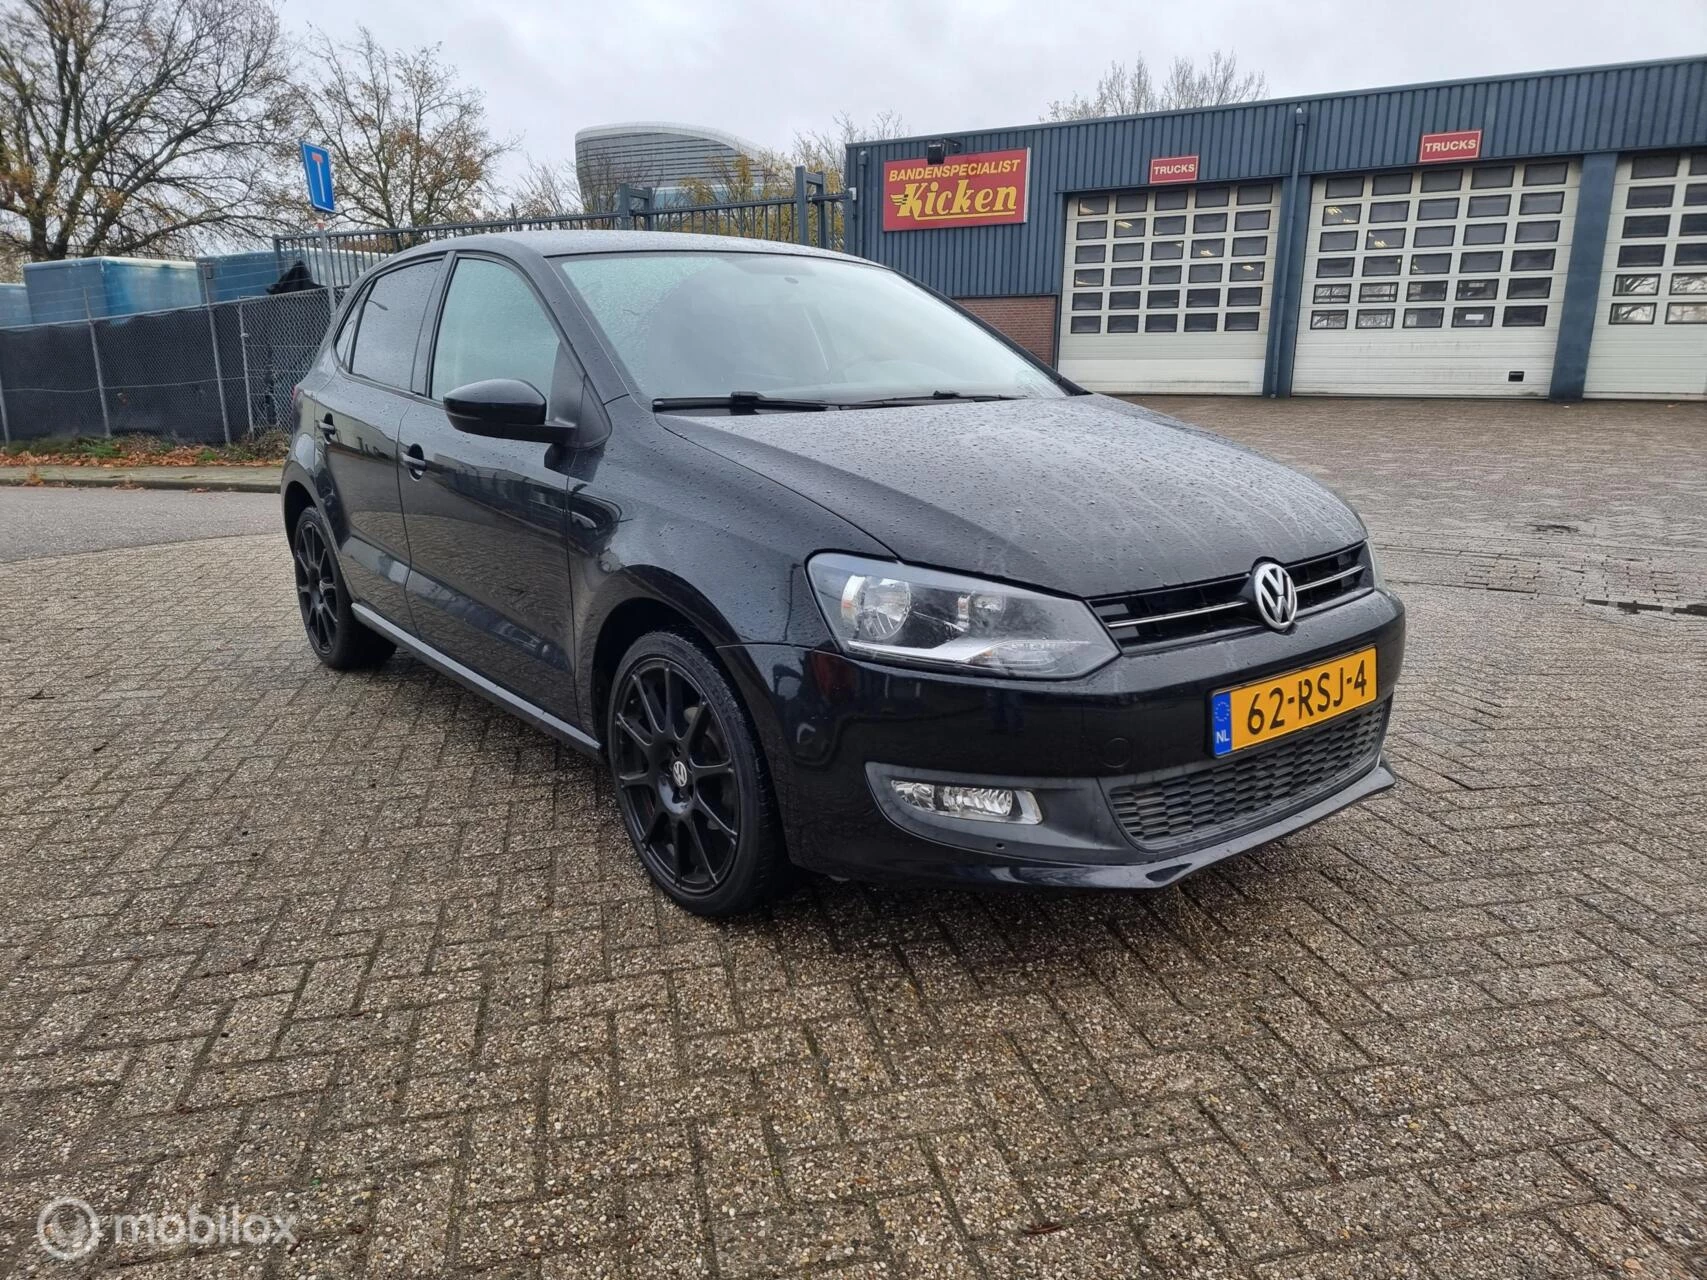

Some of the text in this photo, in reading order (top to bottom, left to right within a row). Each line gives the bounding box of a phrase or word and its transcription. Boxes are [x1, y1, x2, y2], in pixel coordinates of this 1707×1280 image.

[1425, 138, 1477, 153] TRUCKS
[888, 159, 1021, 182] BANDENSPECIALIST
[1153, 163, 1195, 176] TRUCKS
[896, 179, 1017, 221] Kicken
[1247, 659, 1367, 735] 62-RSJ-4
[1216, 729, 1230, 744] NL
